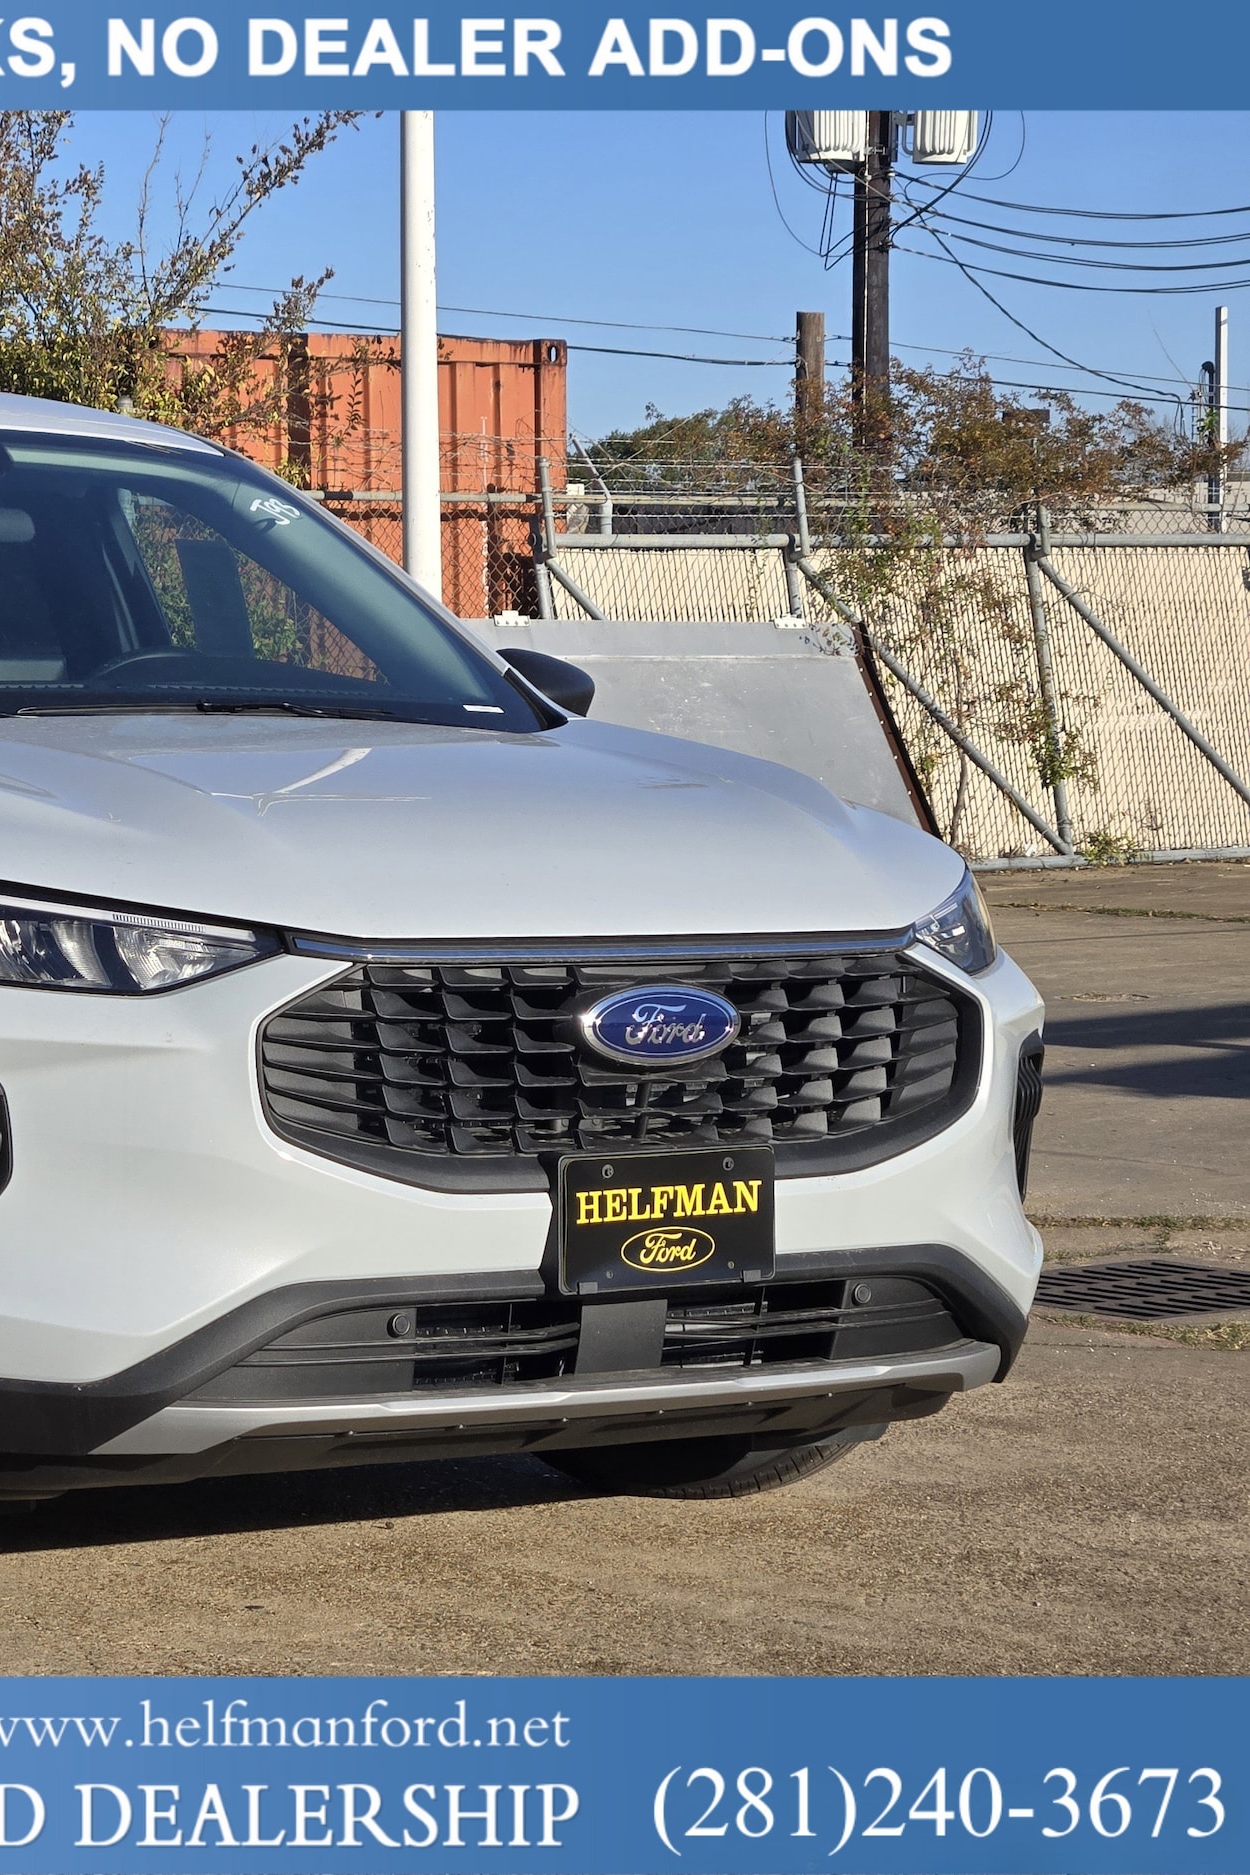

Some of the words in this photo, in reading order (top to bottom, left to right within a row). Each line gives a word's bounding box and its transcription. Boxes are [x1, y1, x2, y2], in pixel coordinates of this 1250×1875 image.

[625, 1003, 707, 1046] Ford
[575, 1180, 763, 1225] HELFMAN
[639, 1231, 697, 1264] Ford
